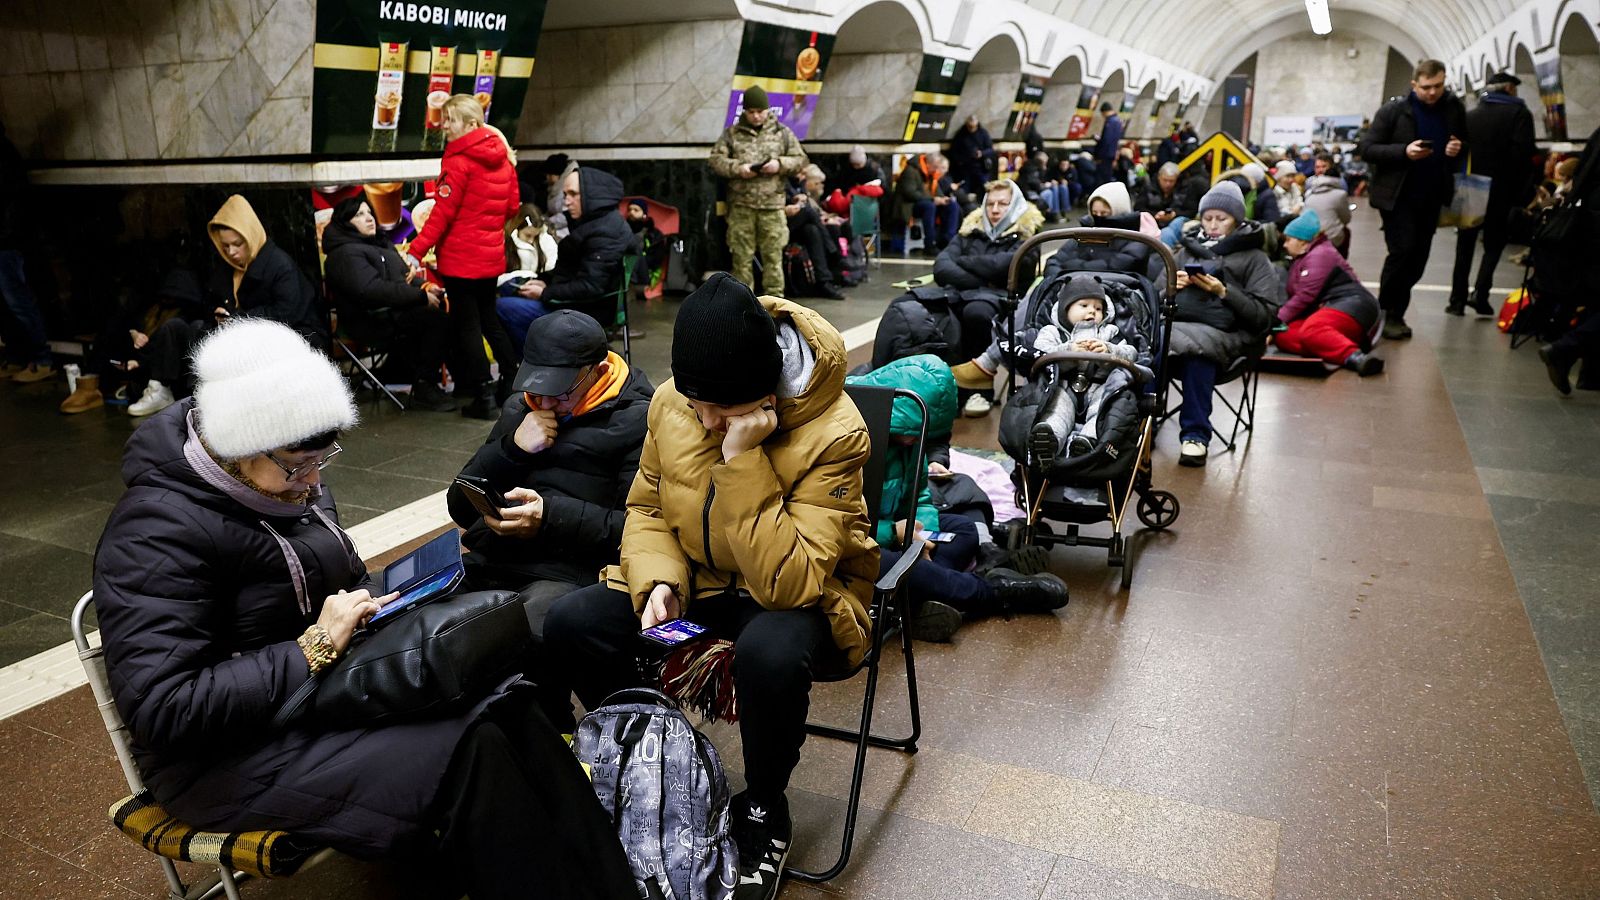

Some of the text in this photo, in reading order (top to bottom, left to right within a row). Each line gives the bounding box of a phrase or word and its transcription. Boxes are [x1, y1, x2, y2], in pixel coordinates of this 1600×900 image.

[379, 1, 507, 31] КАВОВІ МІКСИ
[829, 488, 849, 499] 4F
[747, 815, 764, 824] adidas
